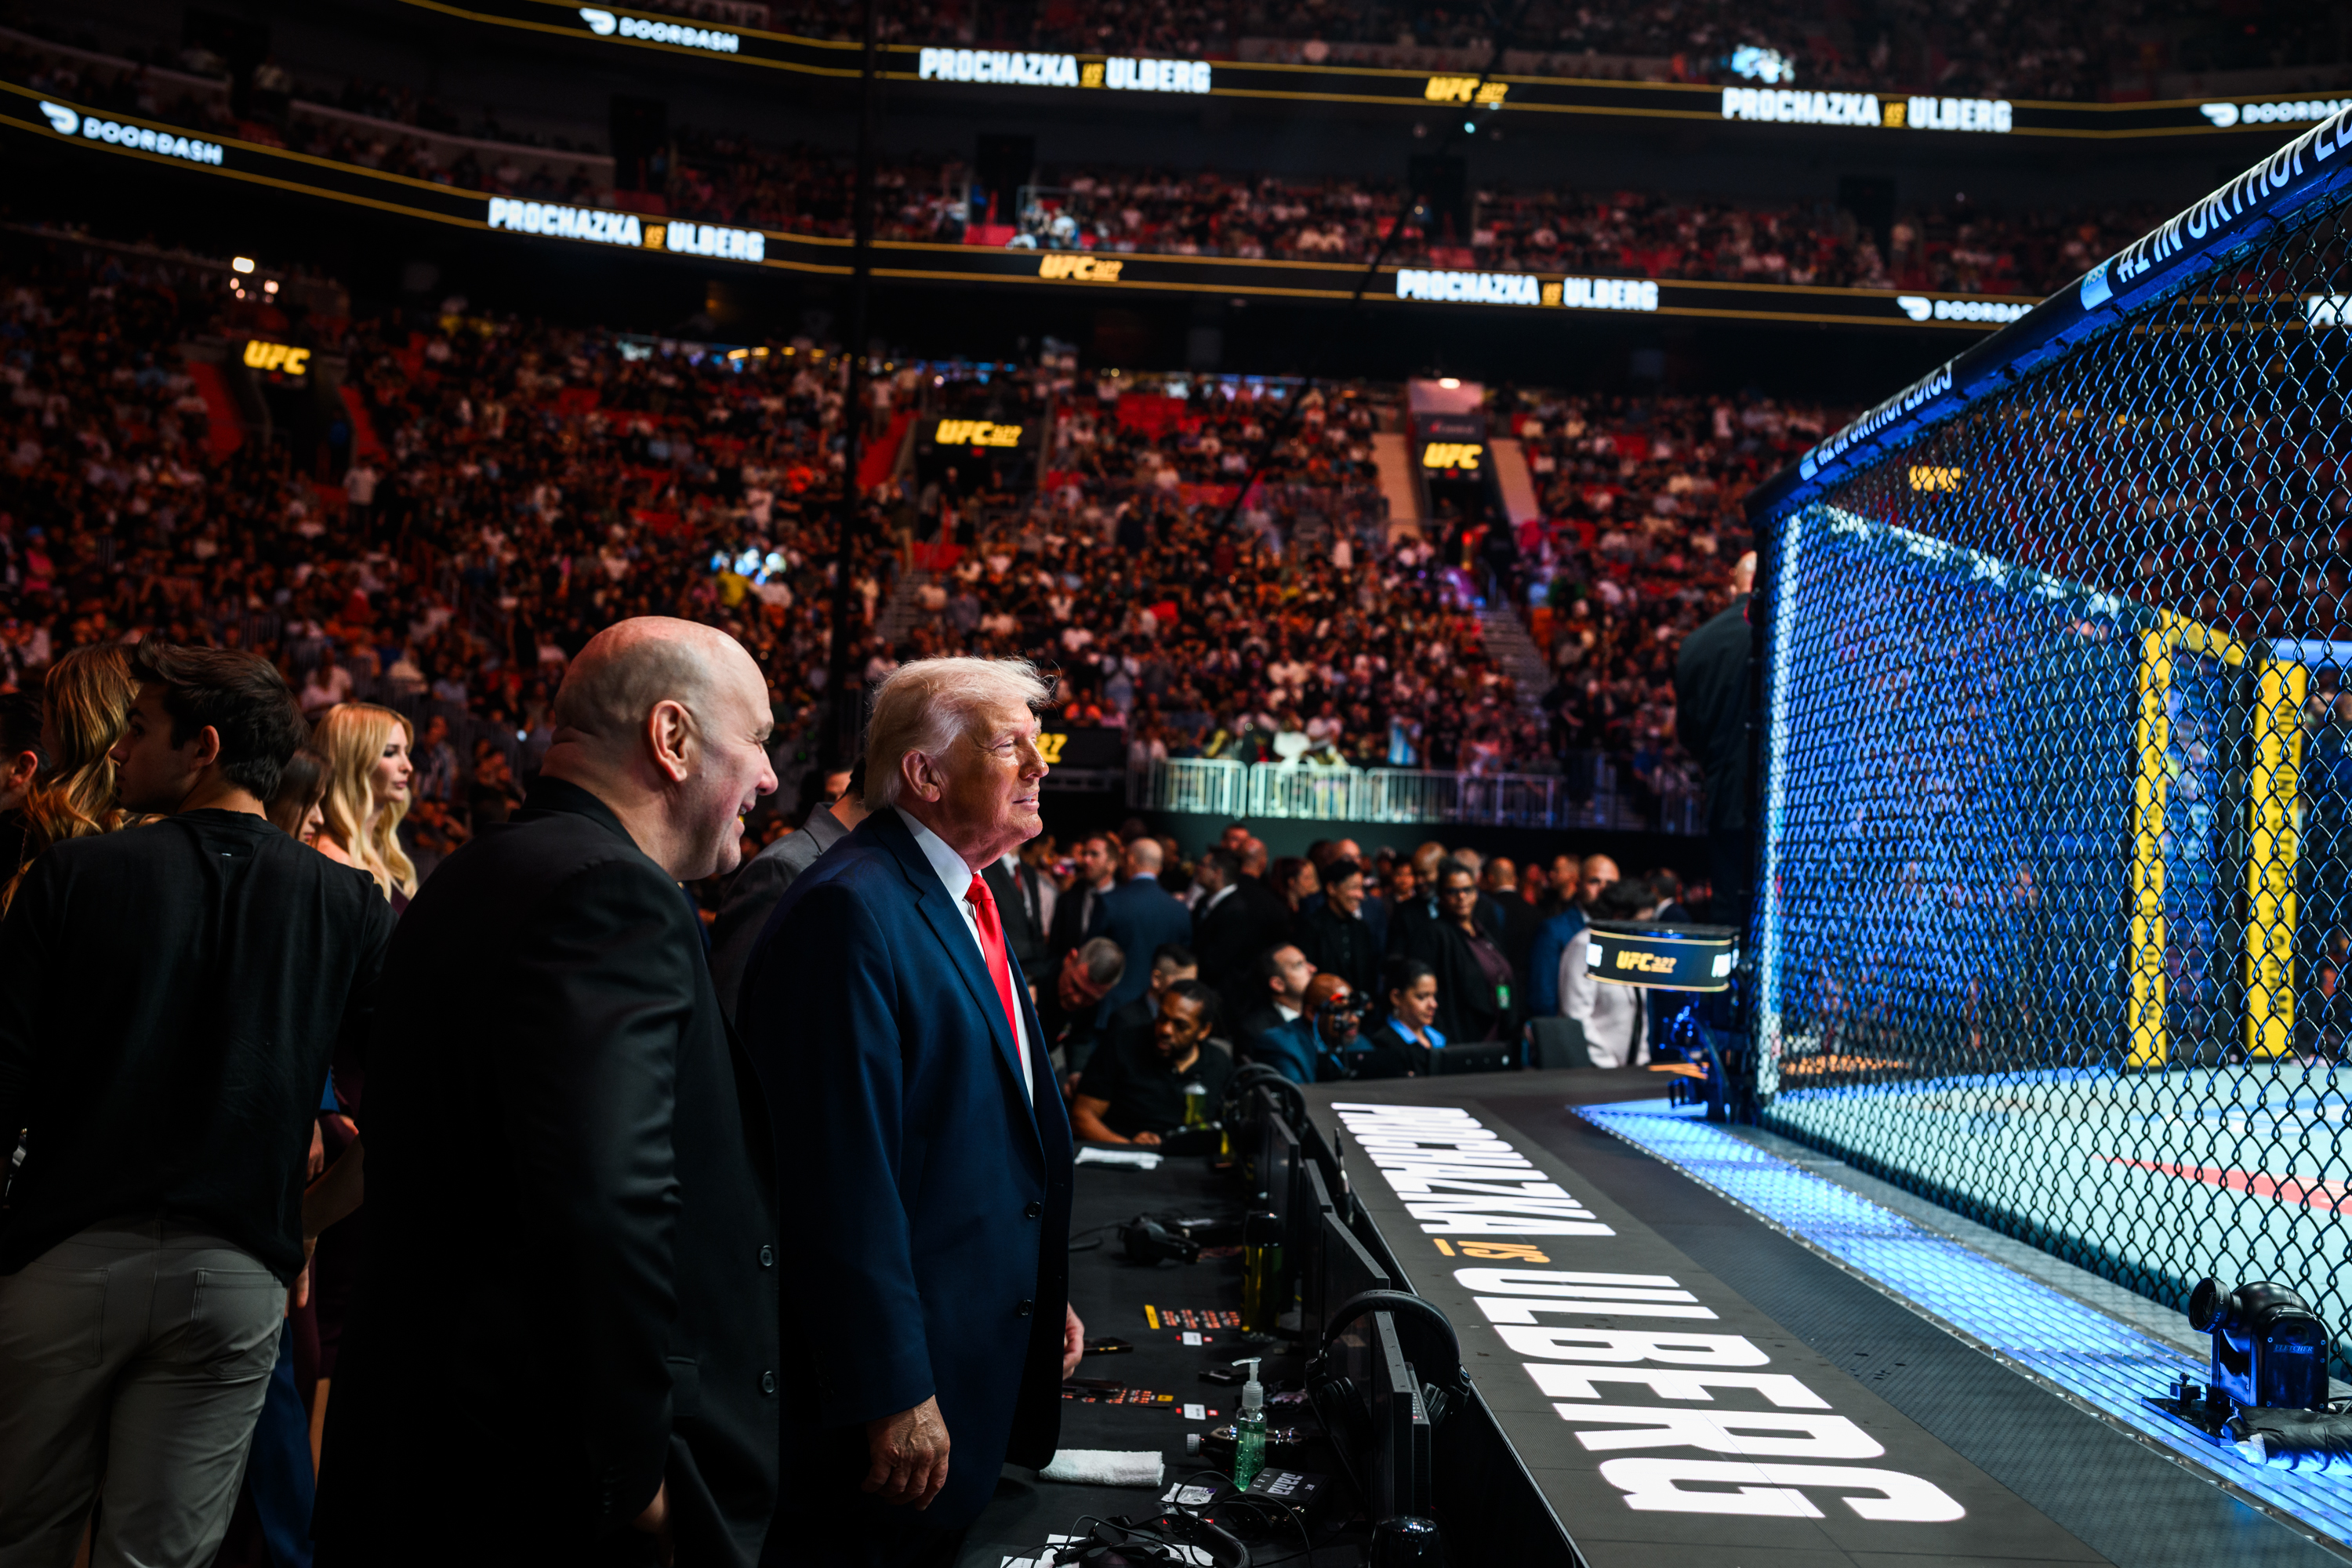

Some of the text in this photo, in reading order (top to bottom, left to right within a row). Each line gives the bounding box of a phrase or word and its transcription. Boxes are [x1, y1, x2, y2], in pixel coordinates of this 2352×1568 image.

[619, 16, 739, 53] DOORDASH
[919, 47, 1079, 88] PROCHAZKA
[1105, 56, 1211, 93] ULBERG
[1425, 76, 1480, 103] UFC
[1721, 86, 1881, 127] PROCHAZKA
[1907, 96, 2013, 132] ULBERG
[83, 118, 223, 165] DOORDASH
[488, 197, 642, 245] PROCHAZKA
[666, 220, 765, 263] ULBERG
[1039, 254, 1095, 281] UFC
[2117, 235, 2152, 283] #1
[2153, 215, 2187, 263] IN
[1396, 268, 1541, 306] PROCHAZKA
[1563, 277, 1659, 312] ULBERG
[244, 339, 310, 376] UFC
[935, 419, 994, 446] UFC
[1423, 442, 1483, 470] UFC
[1036, 732, 1069, 764] 27
[1616, 950, 1655, 972] UFC
[1330, 1102, 1617, 1236] PROCHAZKA
[2274, 1344, 2314, 1352] FLETCHER
[1452, 1268, 1966, 1523] ULBERG
